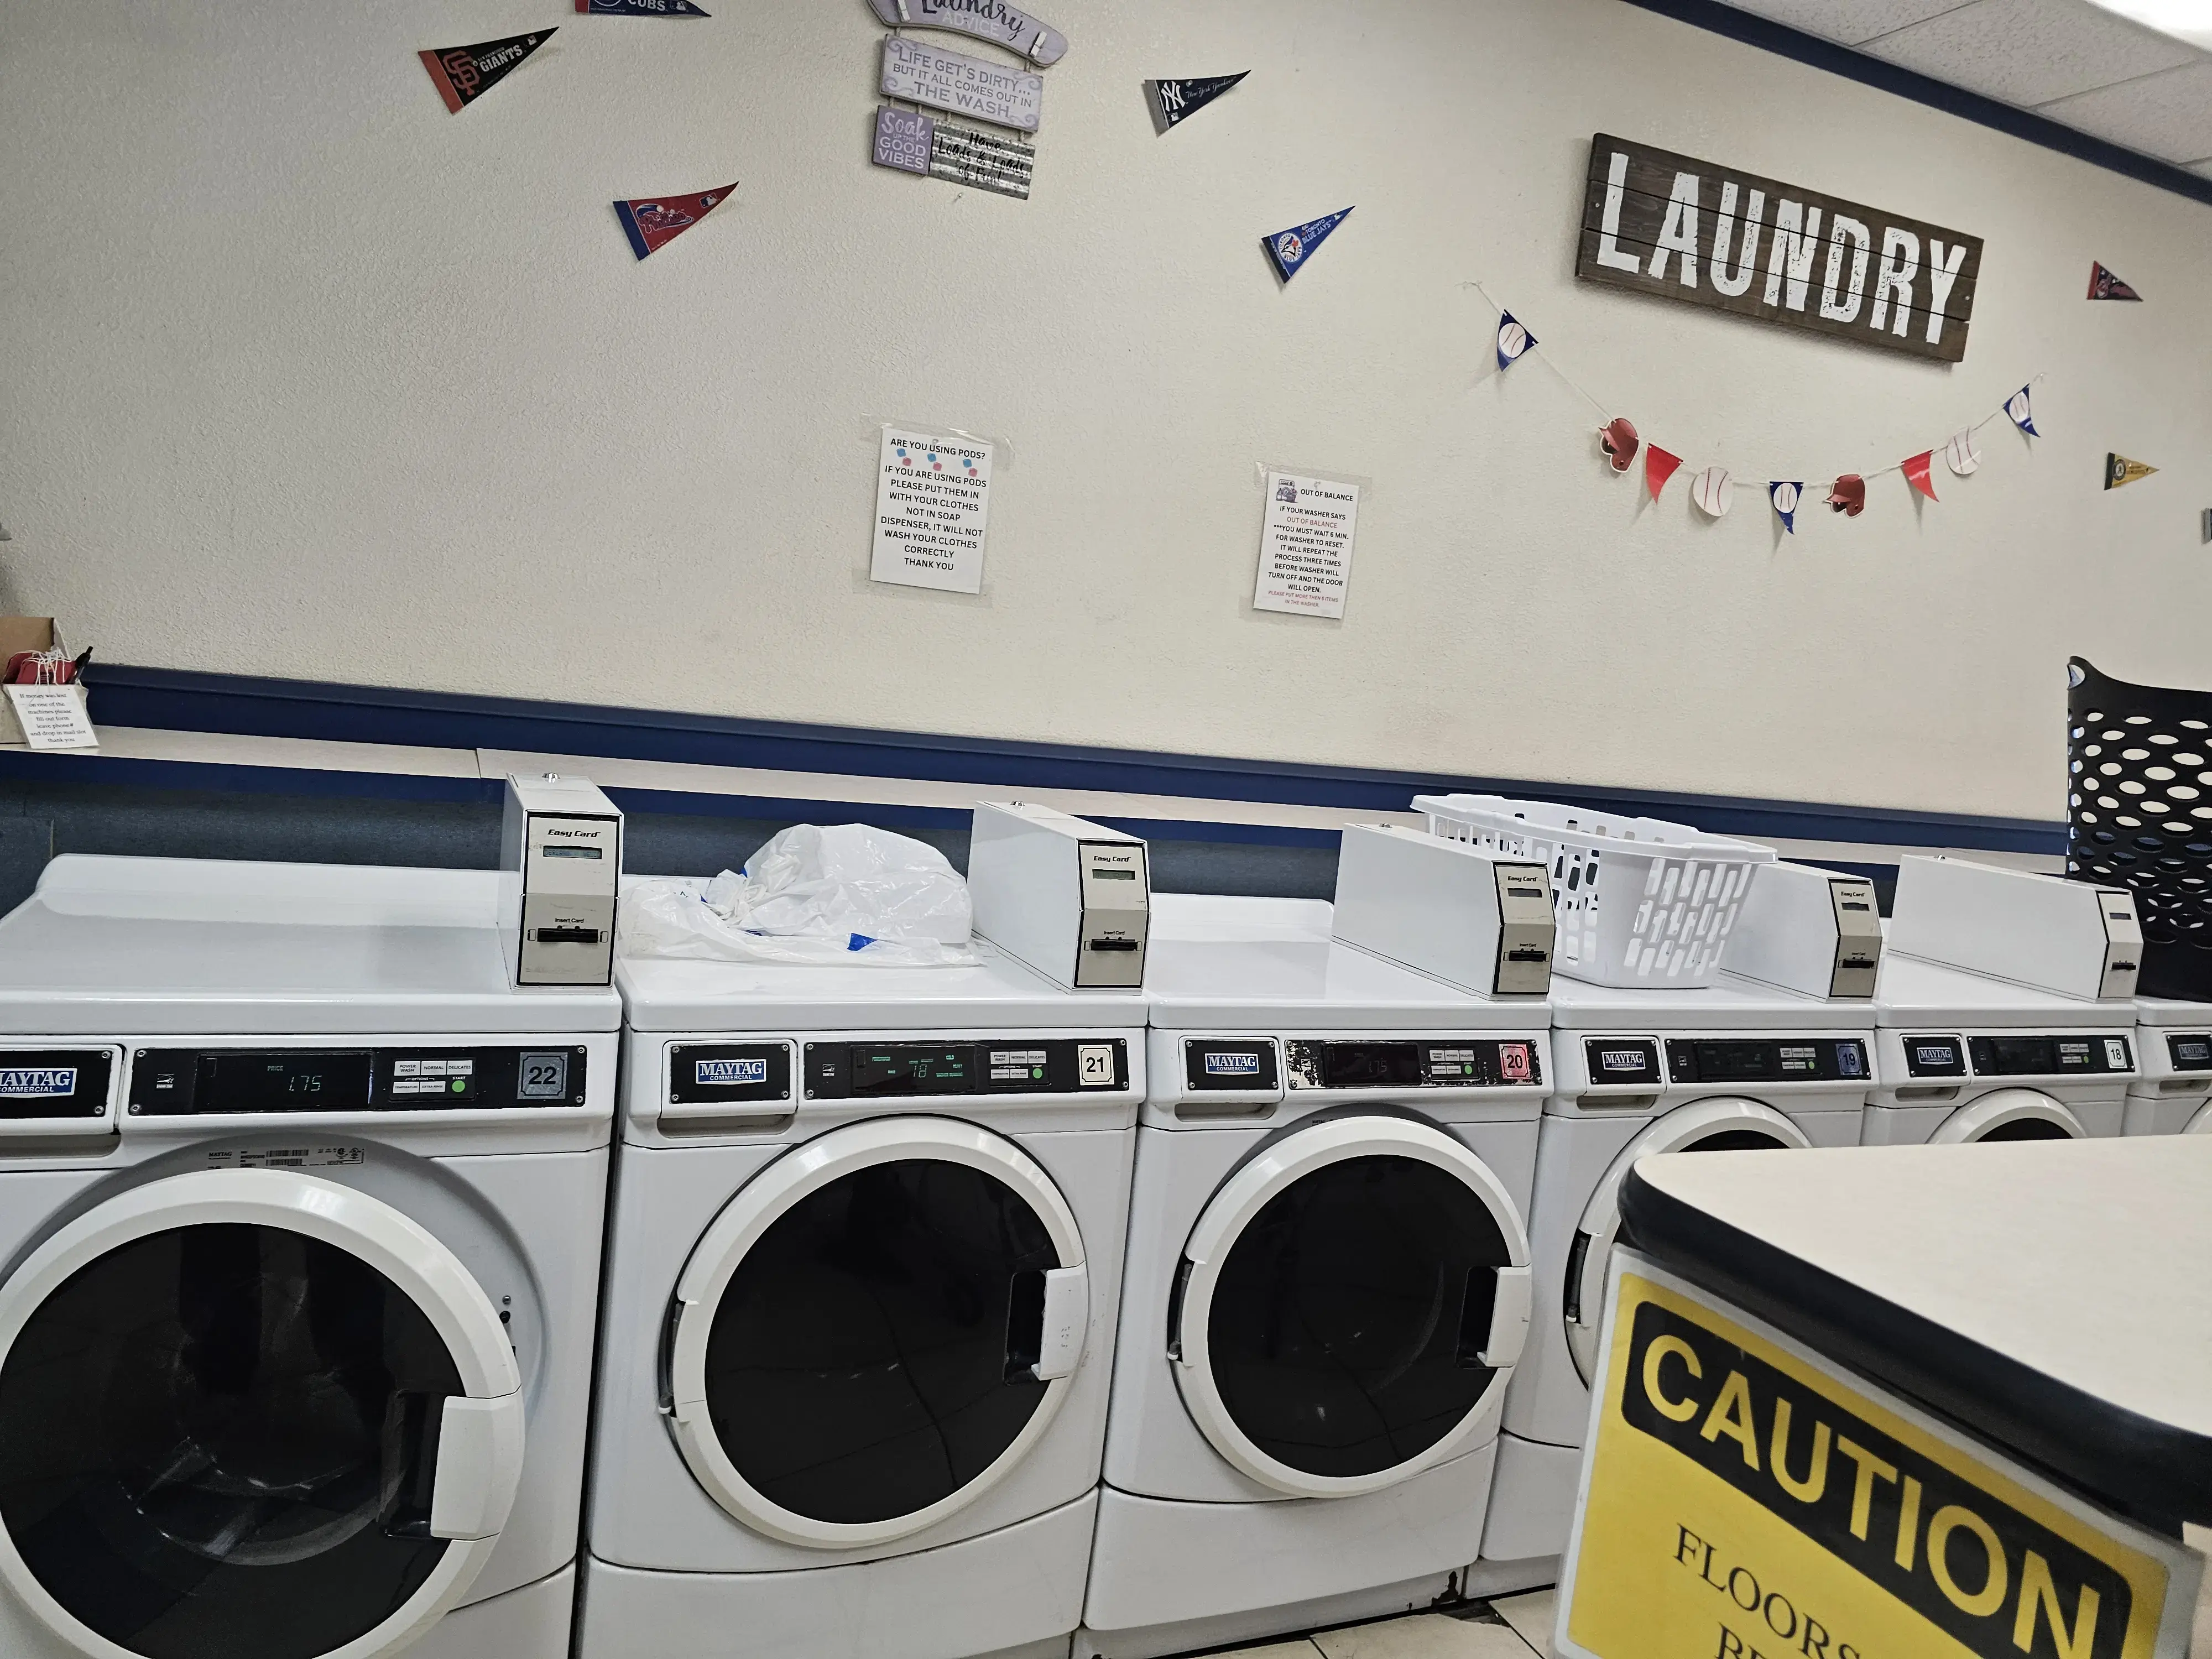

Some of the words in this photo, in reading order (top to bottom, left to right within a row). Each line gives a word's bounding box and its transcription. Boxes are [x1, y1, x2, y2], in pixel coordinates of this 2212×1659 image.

[942, 10, 1000, 37] ADVICE
[479, 44, 524, 72] GIANTS
[899, 46, 932, 69] LIFE
[935, 59, 976, 80] GET'S
[893, 63, 916, 76] BUT
[918, 70, 929, 80] IT
[931, 74, 952, 87] ALL
[954, 80, 993, 97] COMES
[996, 91, 1019, 104] OUT
[1021, 97, 1032, 108] IN
[1197, 84, 1211, 98] York
[1209, 77, 1234, 93] Yankees
[914, 81, 951, 103] THE
[955, 92, 1010, 118] WASH
[881, 112, 929, 141] Soak
[880, 136, 926, 156] GOOD
[969, 132, 1001, 150] Have
[878, 148, 924, 169] VIBES
[938, 137, 972, 162] Loads
[976, 150, 985, 166] &
[992, 155, 1025, 179] Loads
[958, 163, 970, 180] of
[1301, 231, 1317, 244] BLUE
[1317, 221, 1331, 235] JAYS
[1306, 219, 1326, 234] TORONTO
[1597, 152, 1967, 345] LAUNDRY
[890, 438, 907, 447] ARE
[909, 441, 927, 451] YOU
[930, 445, 956, 455] USING
[958, 448, 985, 460] PODS?
[895, 466, 914, 476] YOU
[915, 470, 932, 479] ARE
[934, 473, 961, 484] USING
[963, 477, 987, 488] PODS
[891, 479, 923, 491] PLEASE
[925, 484, 942, 494] PUT
[943, 487, 968, 498] THEM
[1324, 492, 1353, 502] BALANCE
[889, 491, 911, 502] WITH
[914, 495, 938, 505] YOUR
[940, 499, 979, 512] CLOTHES
[906, 507, 925, 516] NOT
[937, 512, 961, 521] SOAP
[1304, 509, 1330, 518] WASHER
[1331, 512, 1346, 520] SAYS
[880, 516, 932, 531] DISPENSER,
[943, 525, 963, 535] WILL
[965, 528, 983, 537] NOT
[1310, 519, 1338, 529] BALANCE
[884, 529, 910, 540] WASH
[912, 533, 937, 544] YOUR
[938, 537, 977, 549] CLOTHES
[1289, 536, 1314, 545] WASHER
[904, 545, 954, 558] CORRECTLY
[1275, 553, 1302, 562] PROCESS
[1302, 547, 1325, 555] REPEAT
[904, 557, 934, 568] THANK
[936, 561, 954, 571] YOU
[1275, 563, 1298, 571] BEFORE
[1299, 566, 1324, 574] WASHER
[547, 828, 572, 838] Easy
[574, 830, 598, 838] Card
[1208, 1056, 1256, 1067] MAYTAG
[1506, 1054, 1523, 1069] 20
[1604, 1053, 1642, 1064] MAYTAG
[1843, 1052, 1855, 1066] 19
[1919, 1050, 1950, 1058] MAYTAG
[2110, 1048, 2121, 1060] 18
[700, 1062, 763, 1077] MAYTAG
[1086, 1057, 1104, 1073] 21
[528, 1066, 557, 1085] 22
[1642, 1334, 2100, 1659] CAUTION
